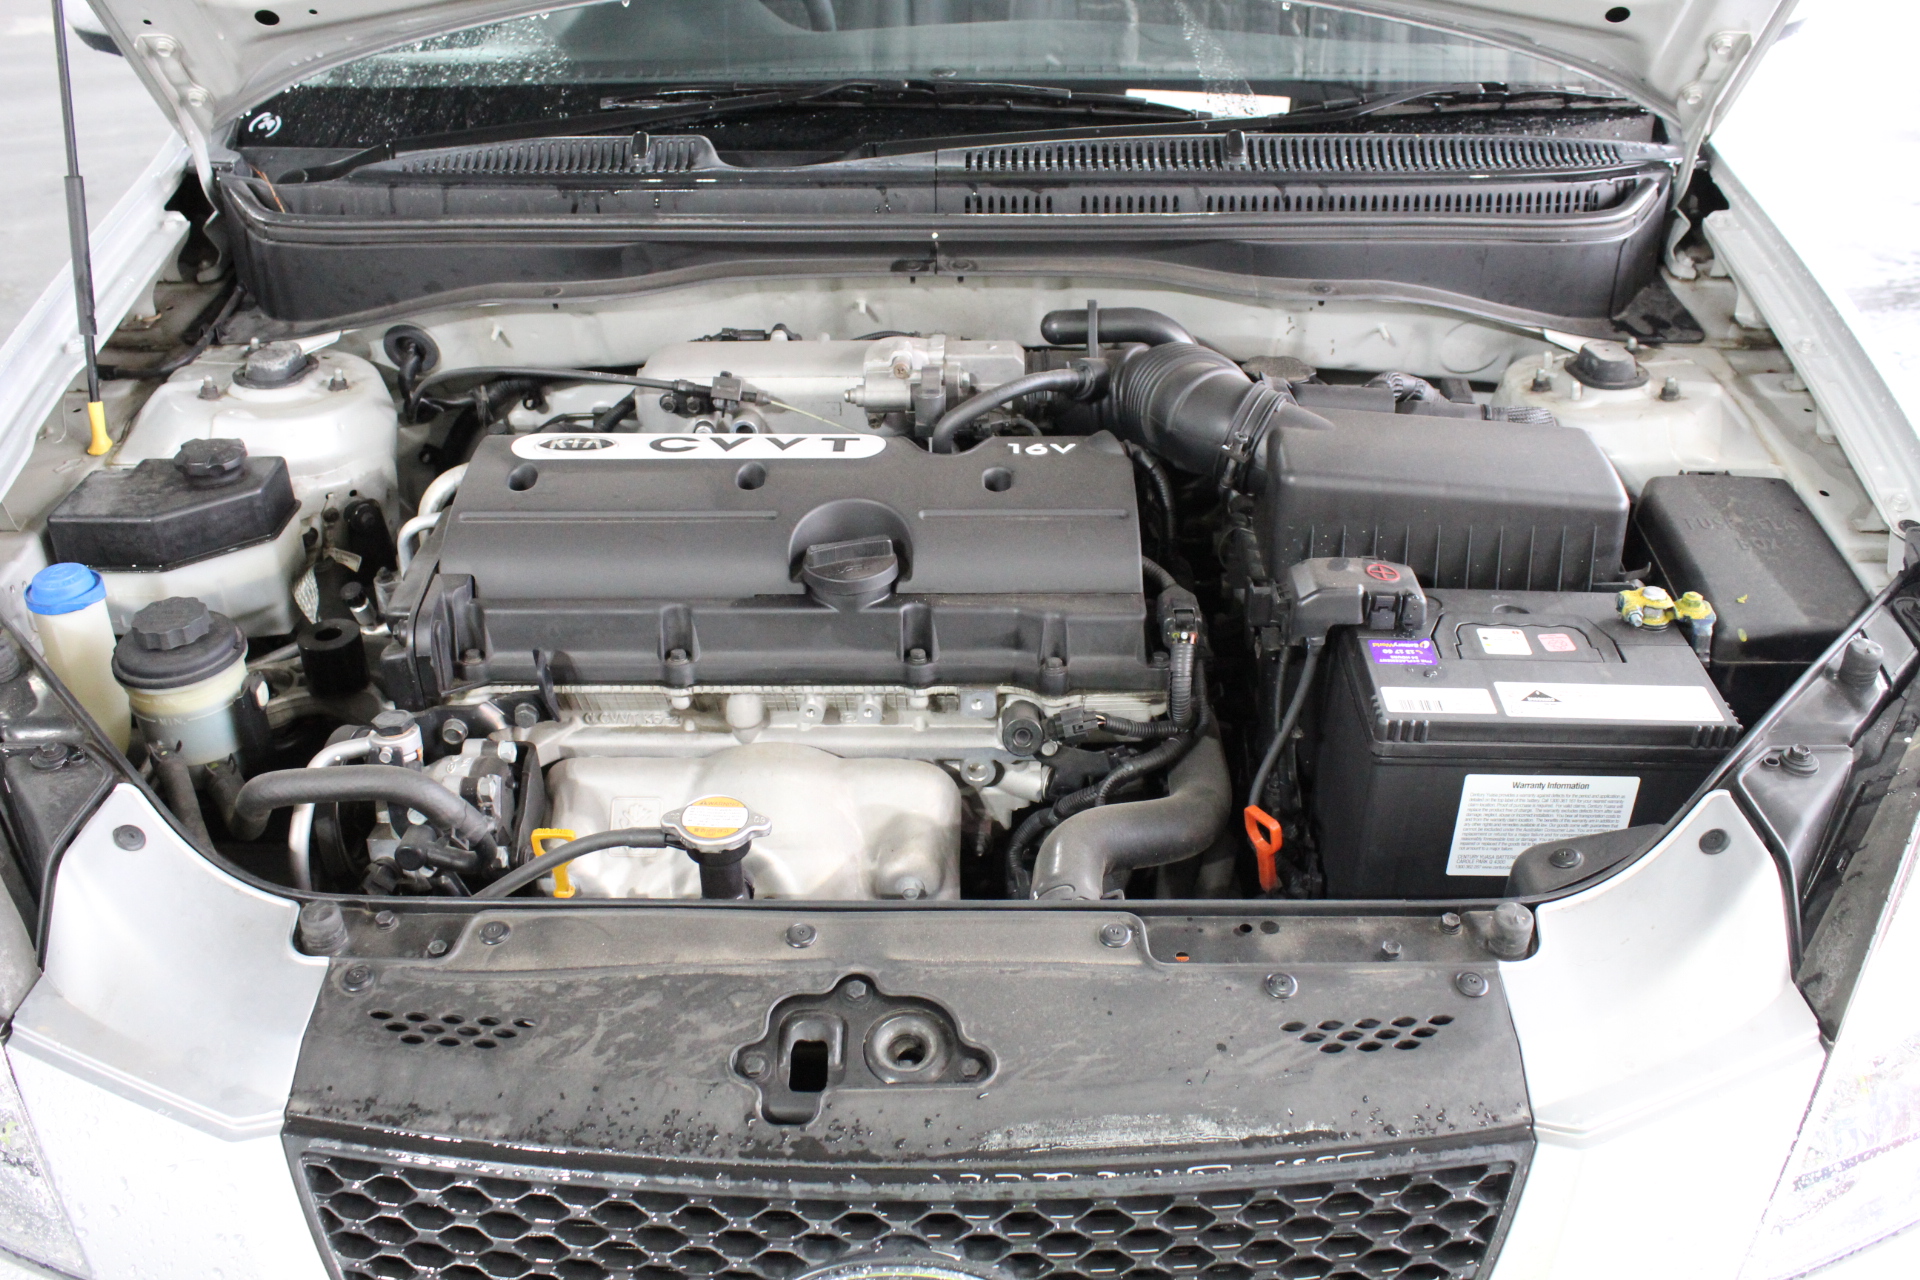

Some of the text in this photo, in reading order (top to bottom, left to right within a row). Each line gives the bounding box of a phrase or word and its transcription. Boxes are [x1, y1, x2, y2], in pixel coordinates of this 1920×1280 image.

[550, 437, 603, 450] KIA
[649, 437, 861, 452] CVVT
[1007, 443, 1077, 456] 16V
[1512, 781, 1546, 790] Warranty
